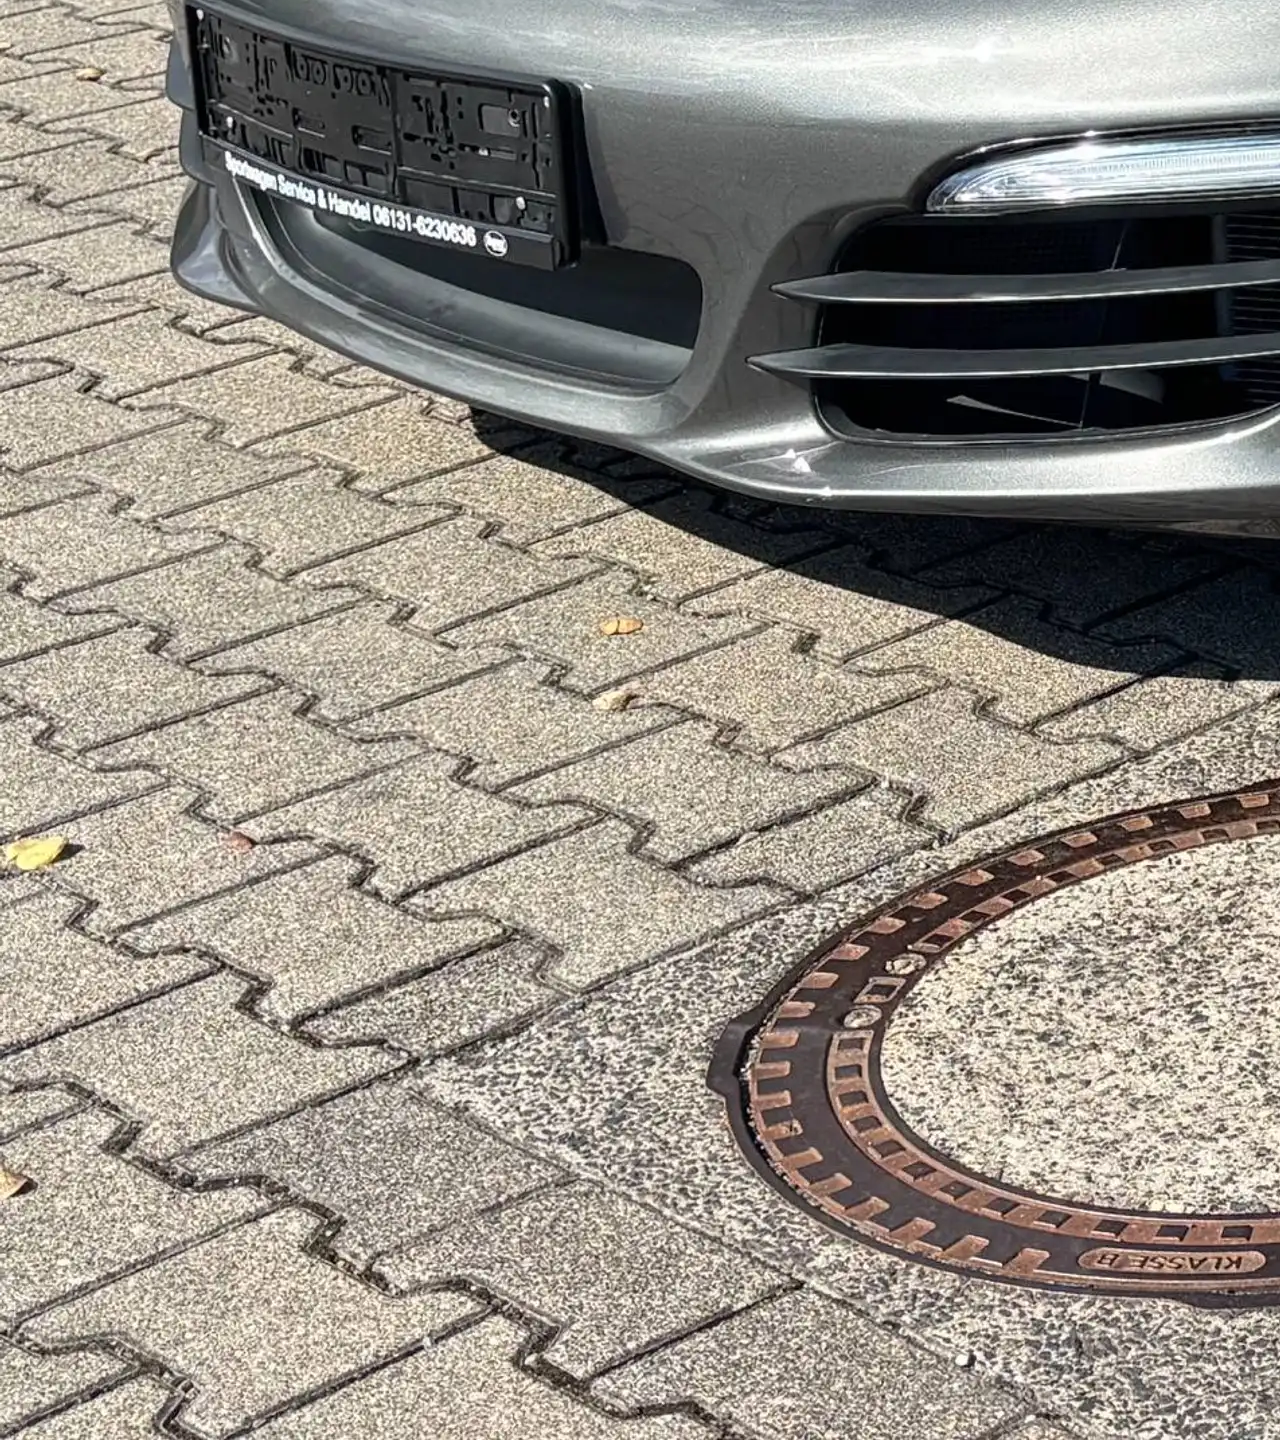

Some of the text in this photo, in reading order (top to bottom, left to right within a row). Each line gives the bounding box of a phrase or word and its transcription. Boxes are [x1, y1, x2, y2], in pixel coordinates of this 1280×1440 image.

[277, 173, 316, 206] Service
[317, 187, 328, 210] &
[328, 191, 372, 223] Handel
[372, 204, 477, 248] 06131-6230636
[1096, 1252, 1243, 1271] KLASSE B
